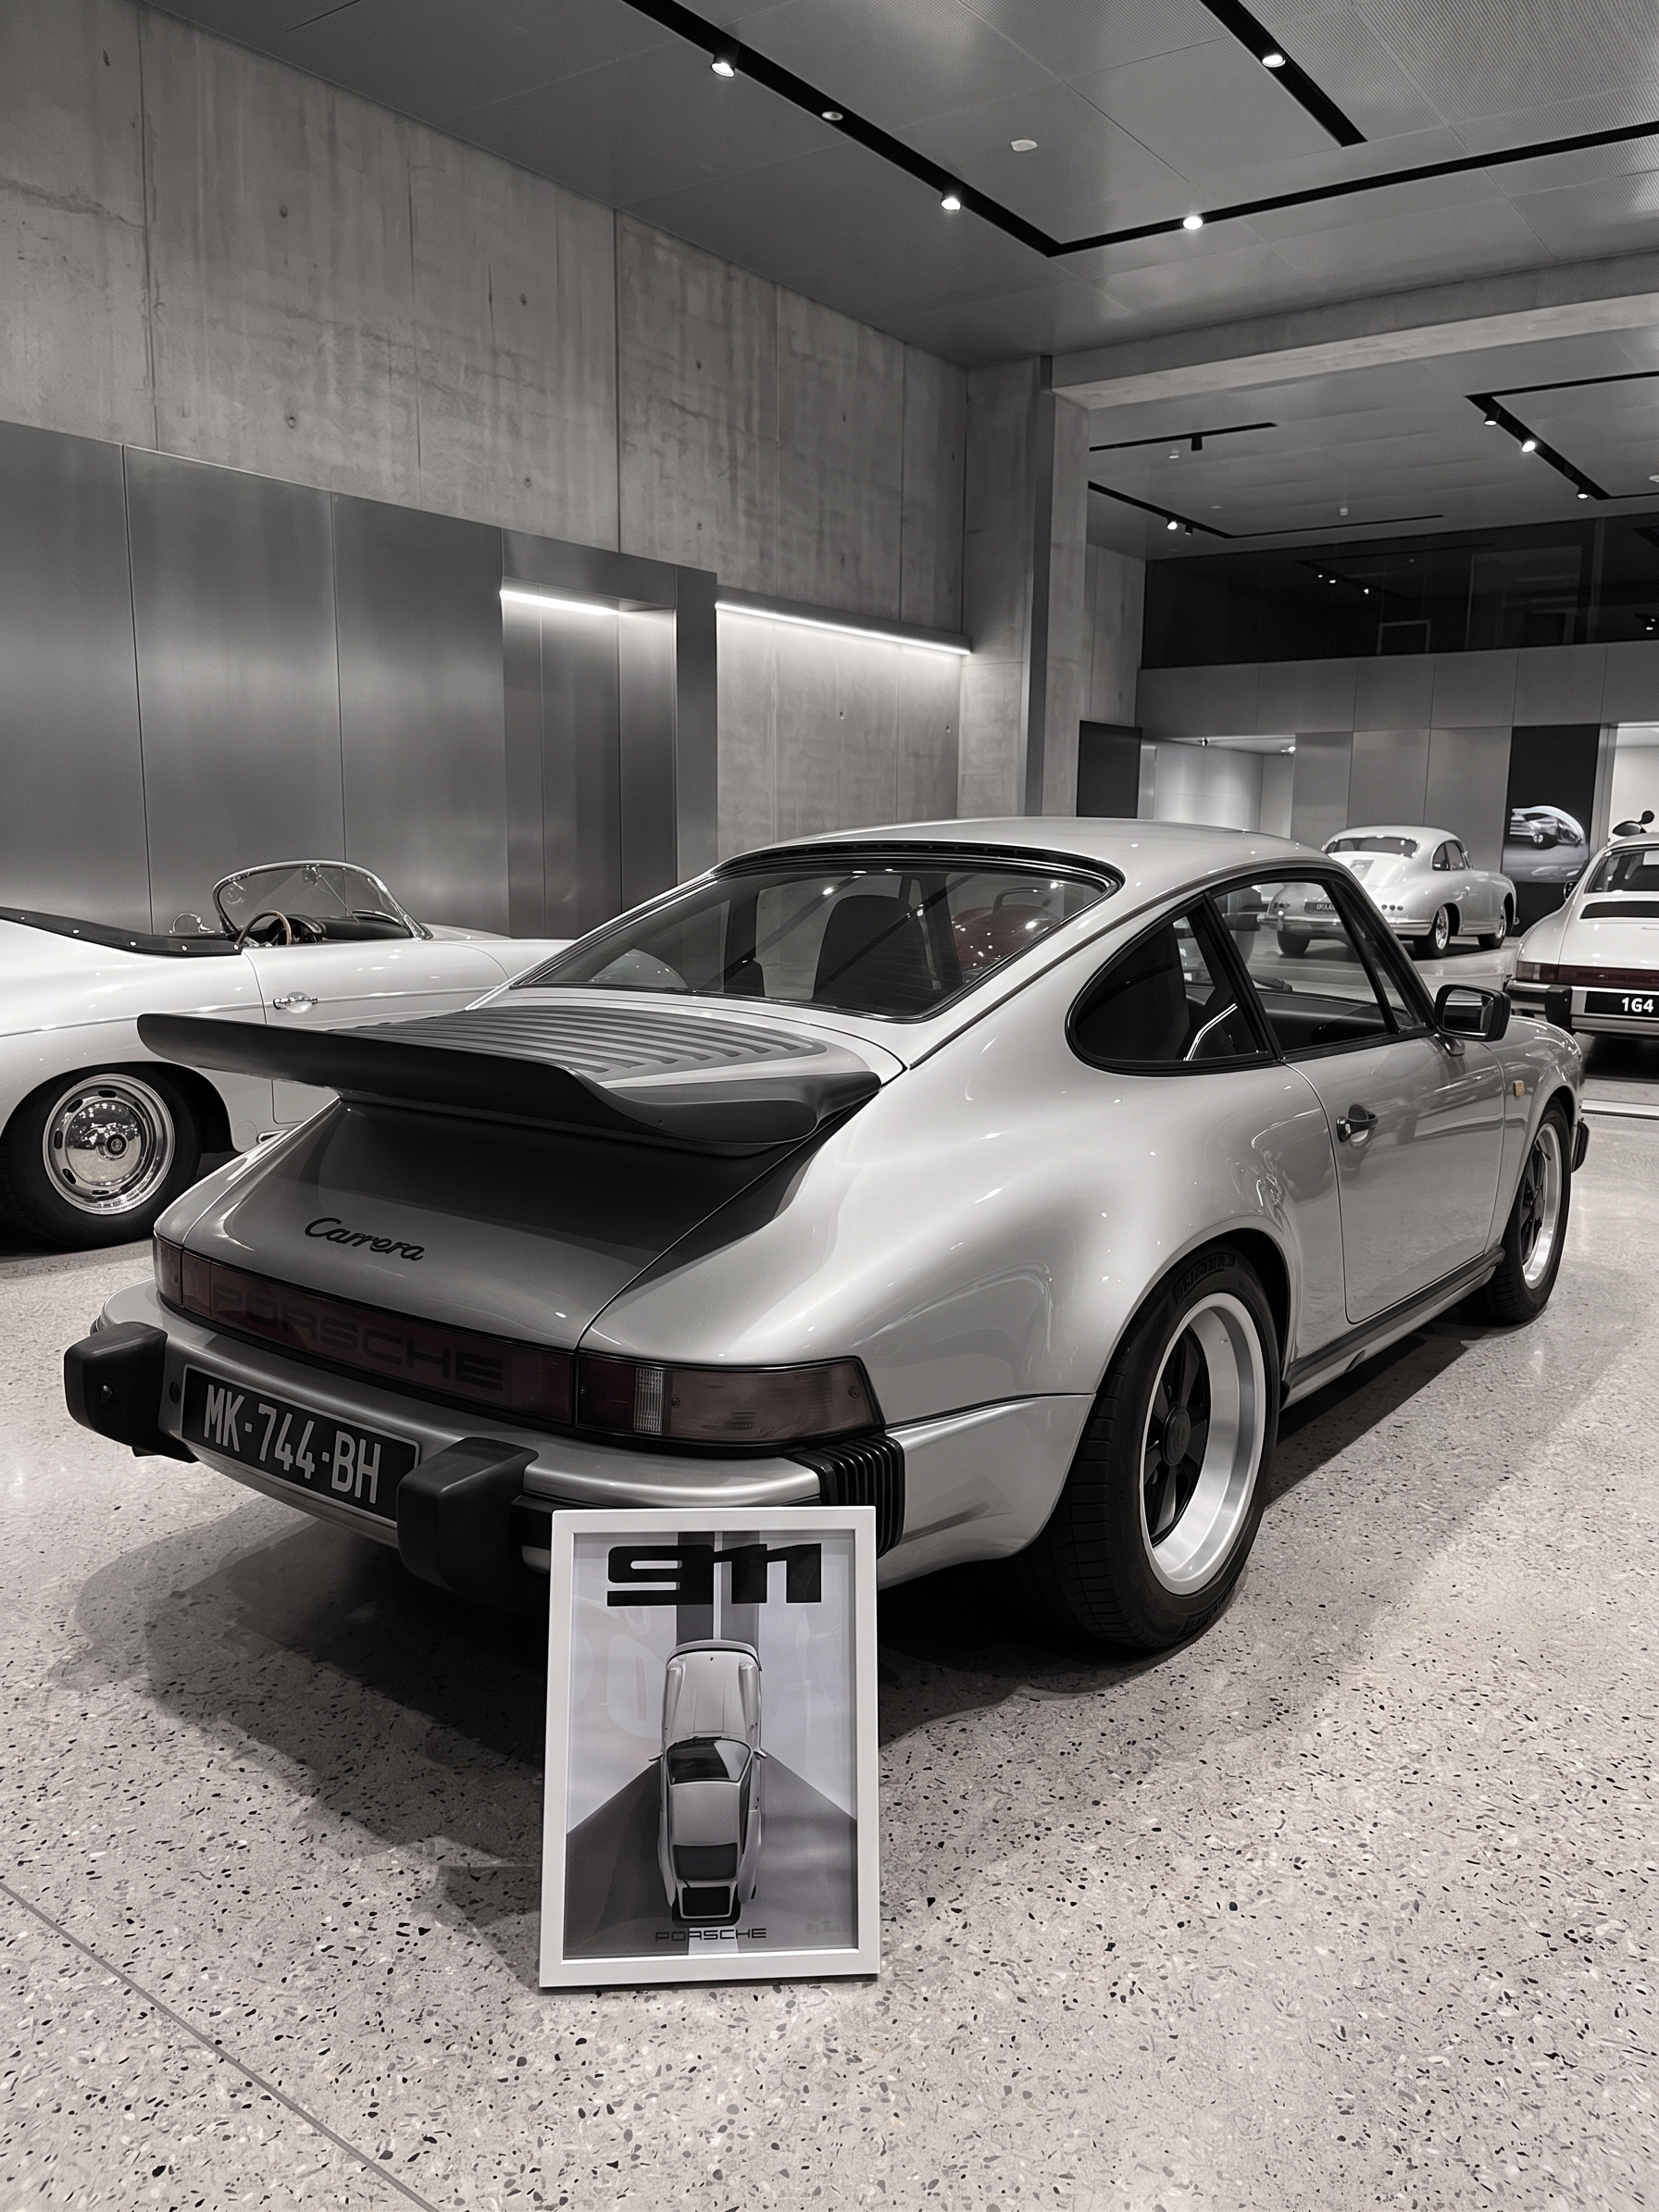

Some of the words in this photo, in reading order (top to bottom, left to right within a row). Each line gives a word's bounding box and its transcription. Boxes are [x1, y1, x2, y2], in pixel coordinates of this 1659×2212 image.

[304, 1217, 426, 1261] Carrera
[212, 1282, 505, 1392] PORSCHE
[204, 1384, 381, 1505] MK-744-BH
[606, 1542, 822, 1607] 911
[655, 1928, 767, 1943] PORSCHE
